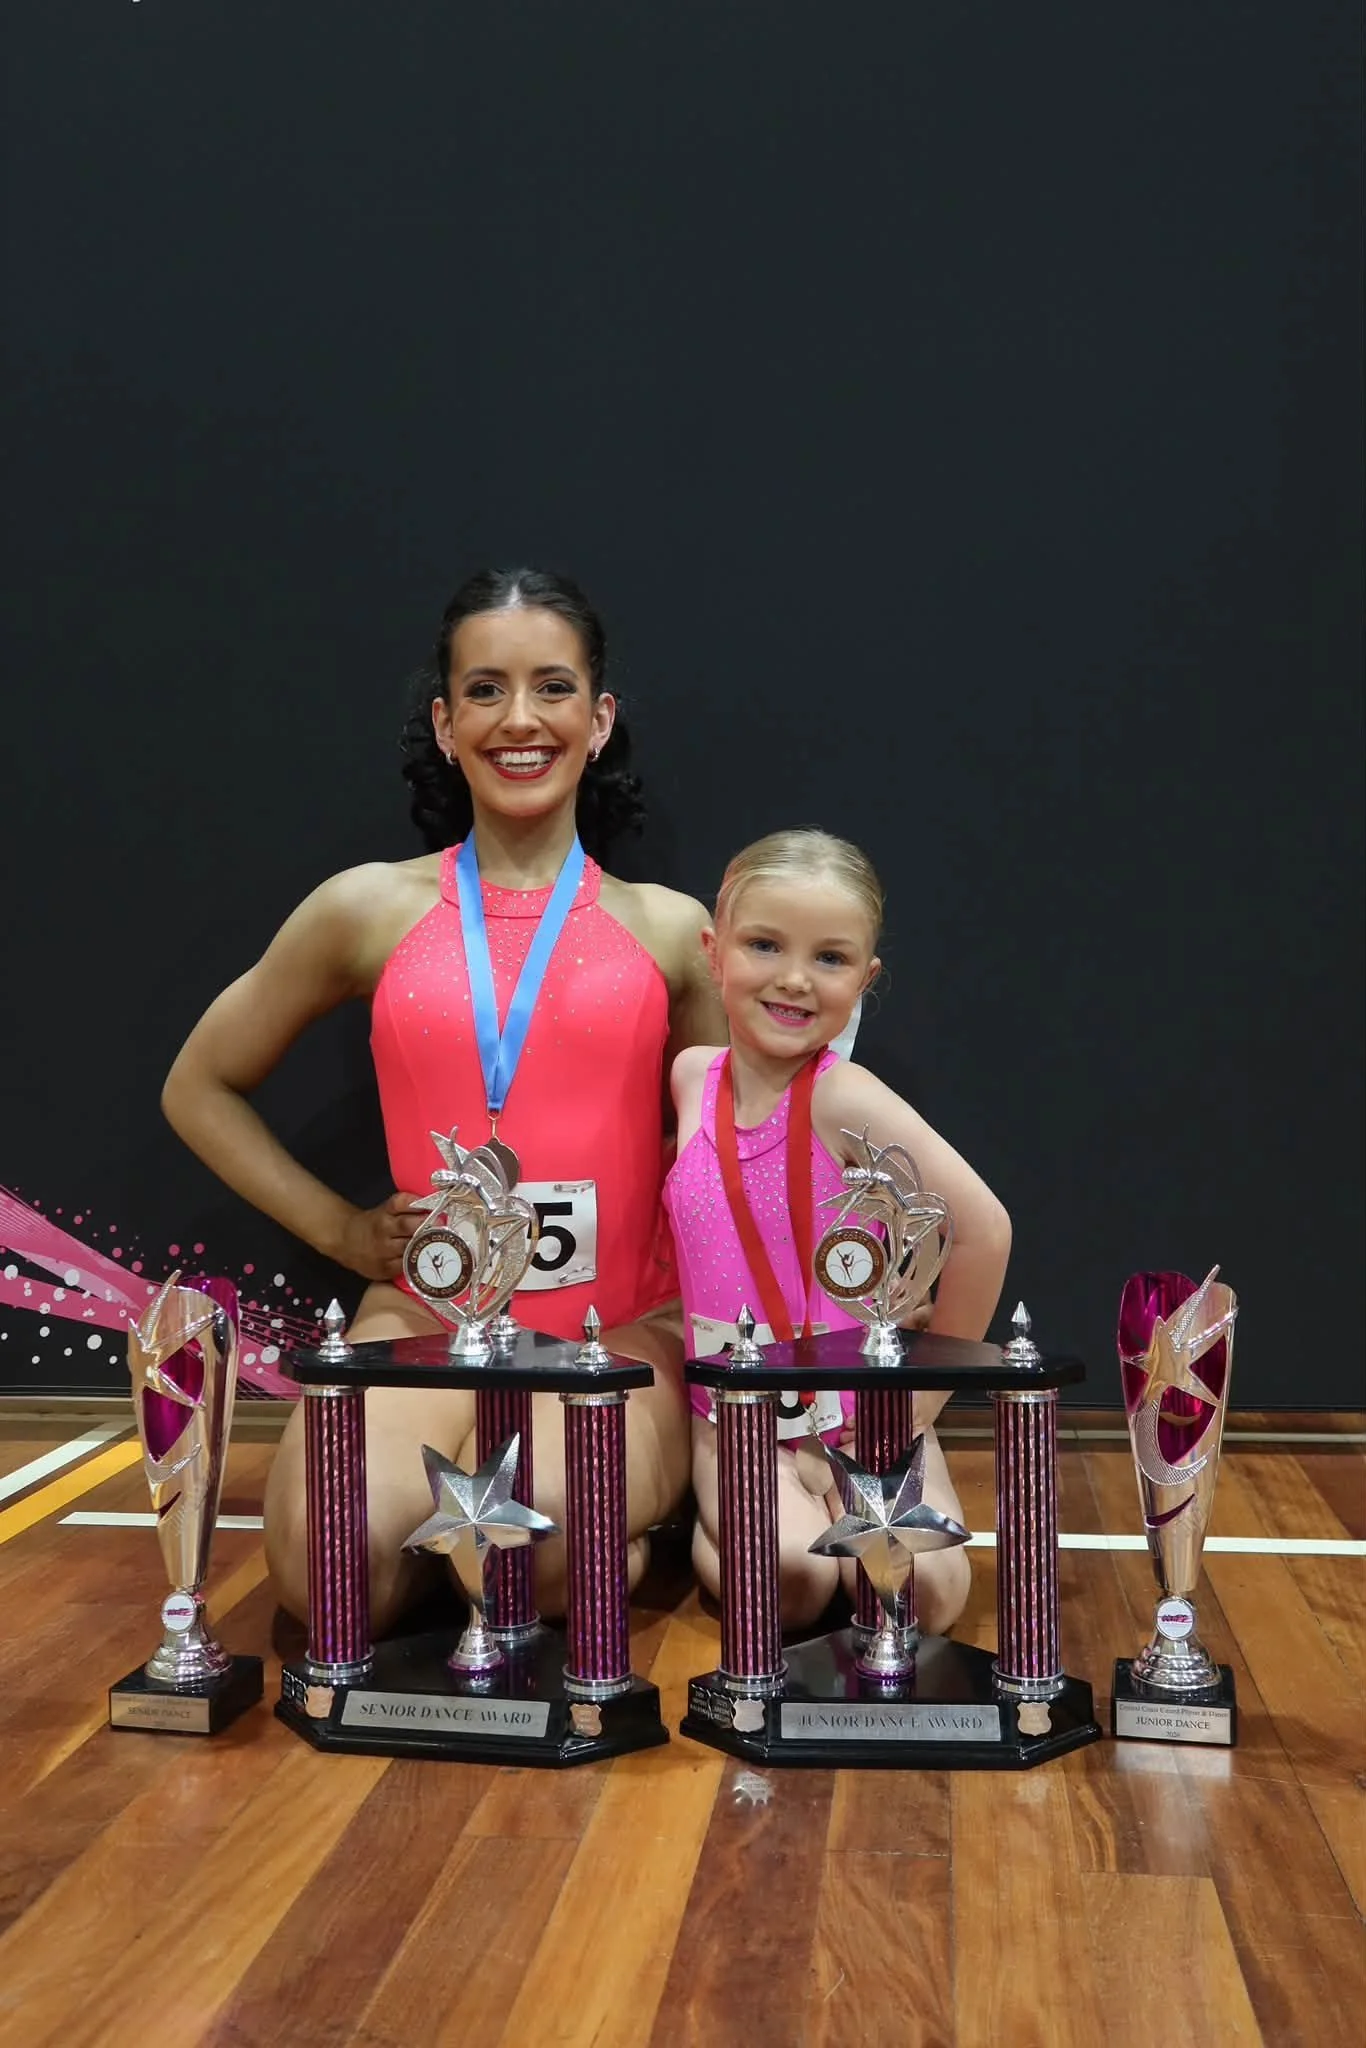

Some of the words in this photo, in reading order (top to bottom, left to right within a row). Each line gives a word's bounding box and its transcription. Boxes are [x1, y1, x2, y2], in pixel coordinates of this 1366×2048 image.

[490, 1202, 576, 1271] 5
[360, 1703, 417, 1718] SENIOR
[420, 1706, 474, 1721] DANCE
[479, 1711, 532, 1725] AWARD
[799, 1715, 860, 1728] JUNIOR
[864, 1716, 921, 1729] DANCE
[927, 1717, 984, 1730] AWARD
[1136, 1716, 1173, 1727] JUNIOR
[1176, 1719, 1210, 1730] DANCE
